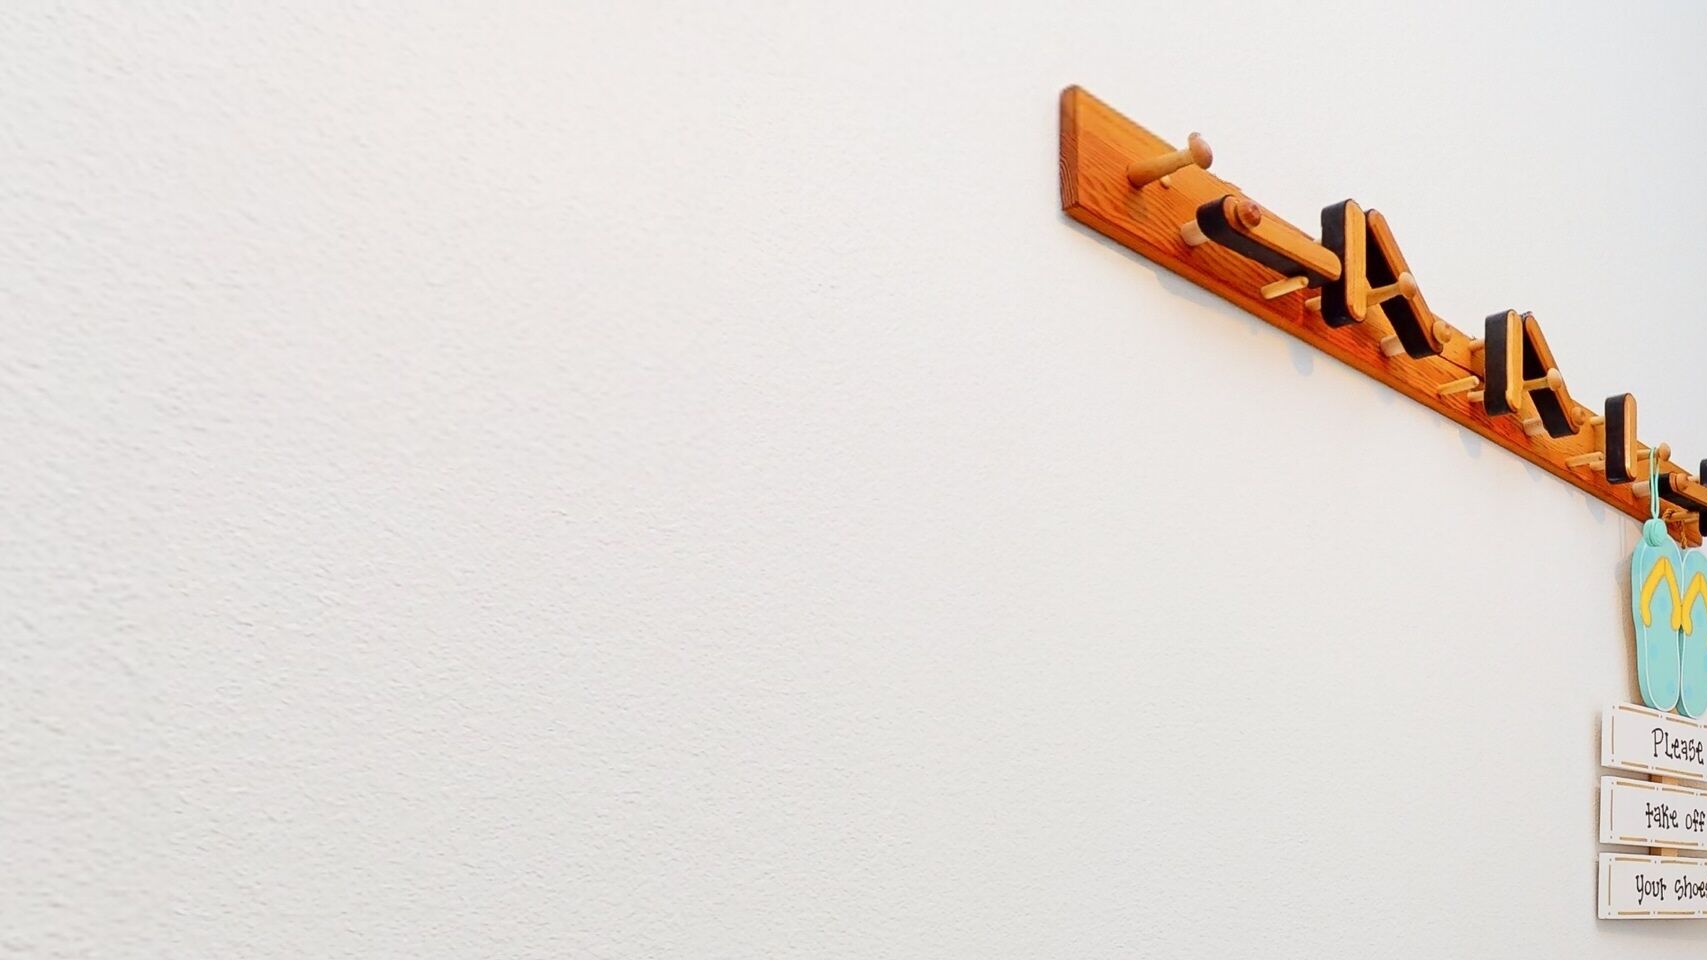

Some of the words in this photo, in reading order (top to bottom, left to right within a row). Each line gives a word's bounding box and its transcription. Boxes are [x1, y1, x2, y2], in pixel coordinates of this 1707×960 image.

[1645, 802, 1679, 829] take
[1685, 809, 1706, 832] off
[1635, 874, 1667, 905] your
